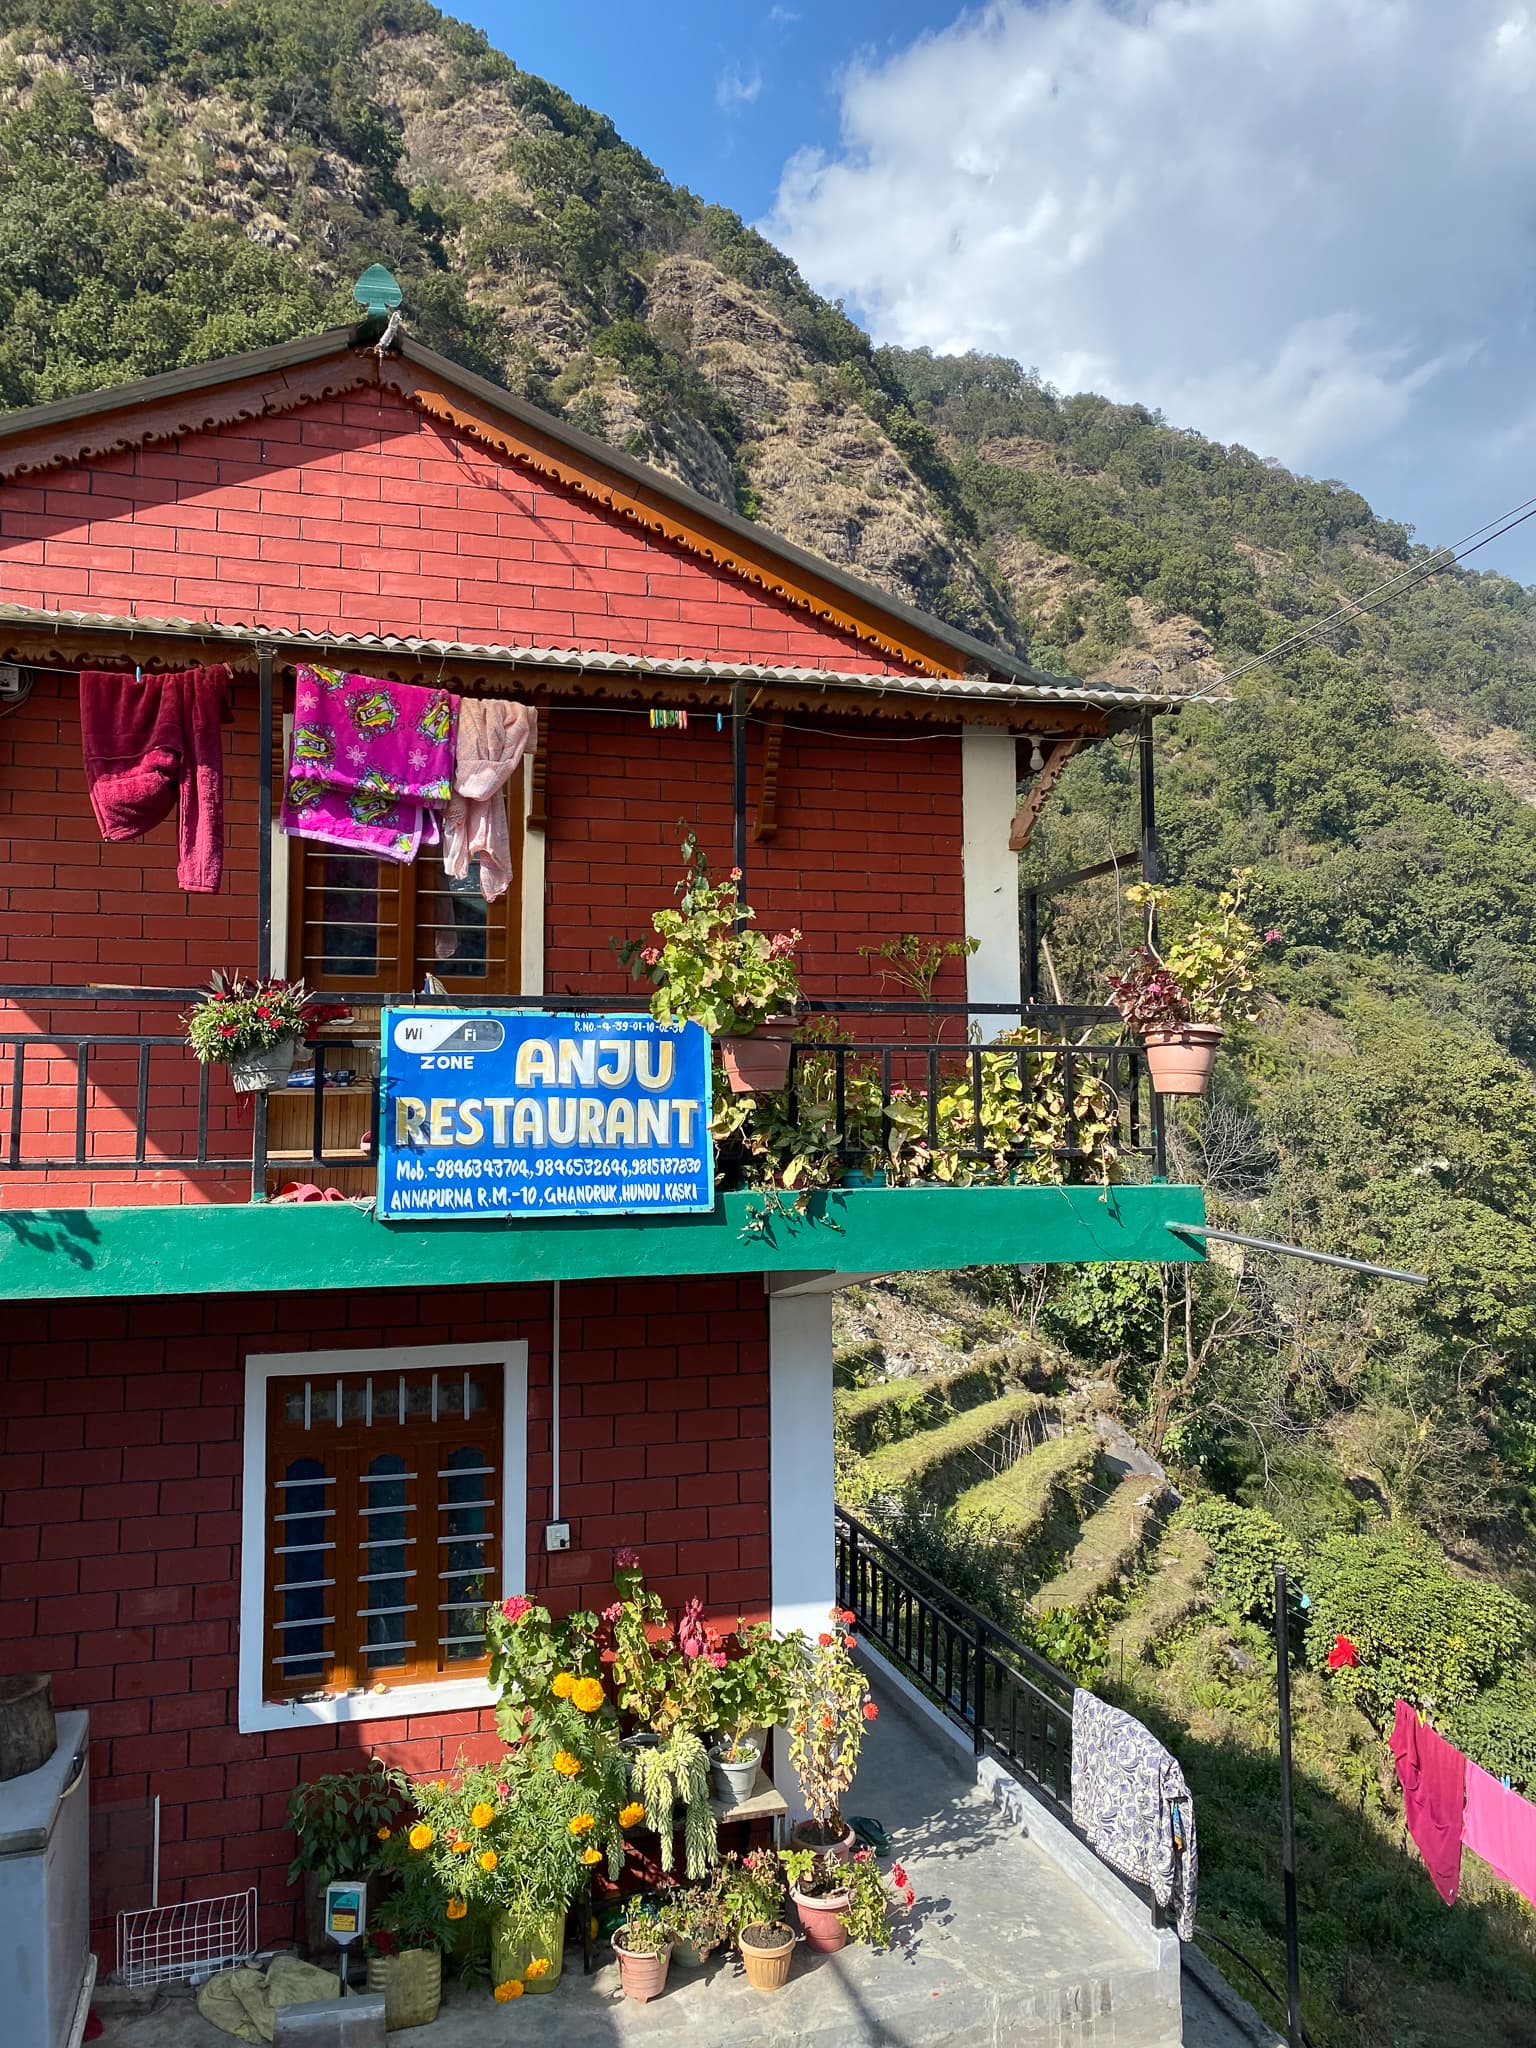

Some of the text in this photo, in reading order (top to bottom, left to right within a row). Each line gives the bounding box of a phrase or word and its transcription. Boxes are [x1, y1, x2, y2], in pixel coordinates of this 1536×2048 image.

[405, 1027, 477, 1042] Wi Fi
[420, 1055, 475, 1070] ZONE
[515, 1038, 676, 1091] ANJU
[394, 1096, 699, 1148] RESTAURANT
[390, 1186, 474, 1211] ANNAPURNA
[665, 1183, 698, 1204] KASKI
